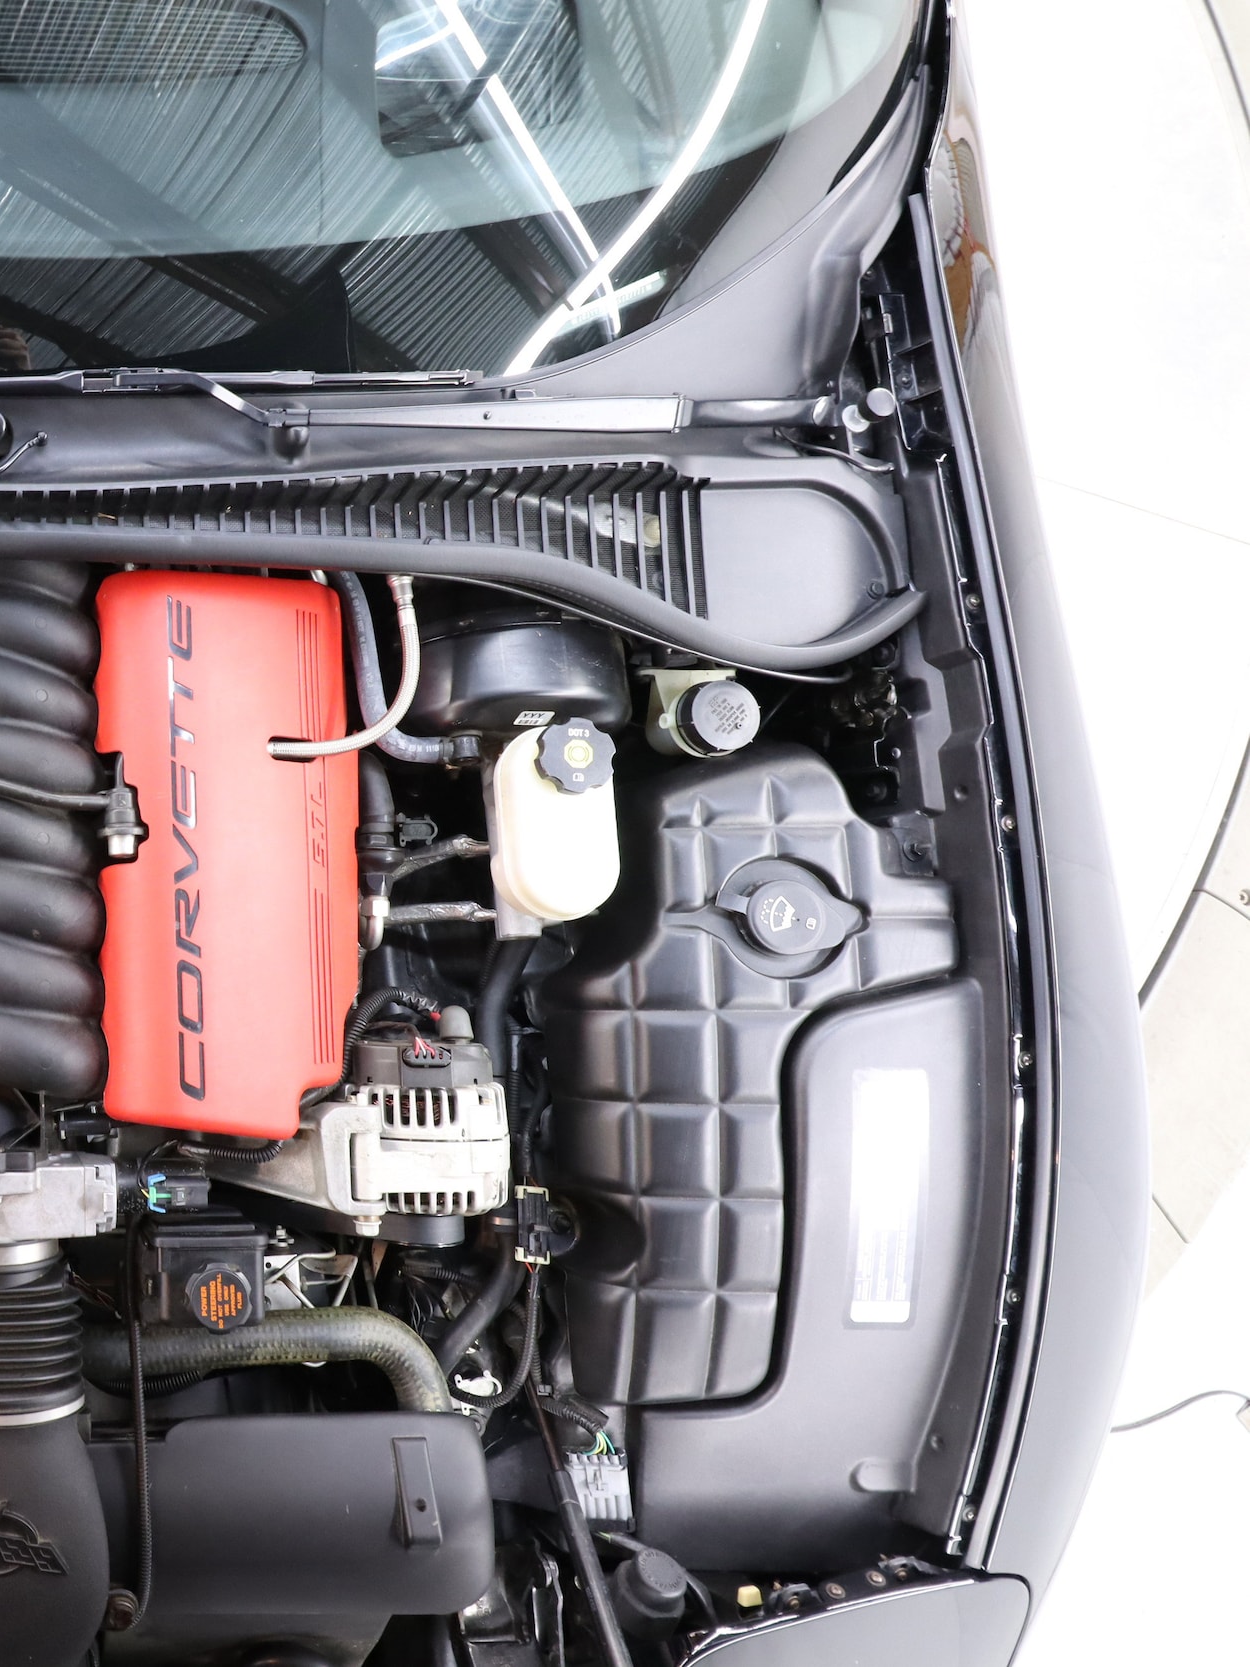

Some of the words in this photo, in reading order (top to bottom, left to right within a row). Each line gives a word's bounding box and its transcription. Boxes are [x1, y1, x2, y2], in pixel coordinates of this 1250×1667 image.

[568, 728, 584, 737] DOT
[584, 729, 590, 738] 3
[311, 781, 327, 869] 5.7L
[166, 594, 206, 1101] CORVETTE
[200, 1286, 208, 1316] POWER
[209, 1280, 217, 1321] STEERING
[218, 1319, 224, 1329] DO
